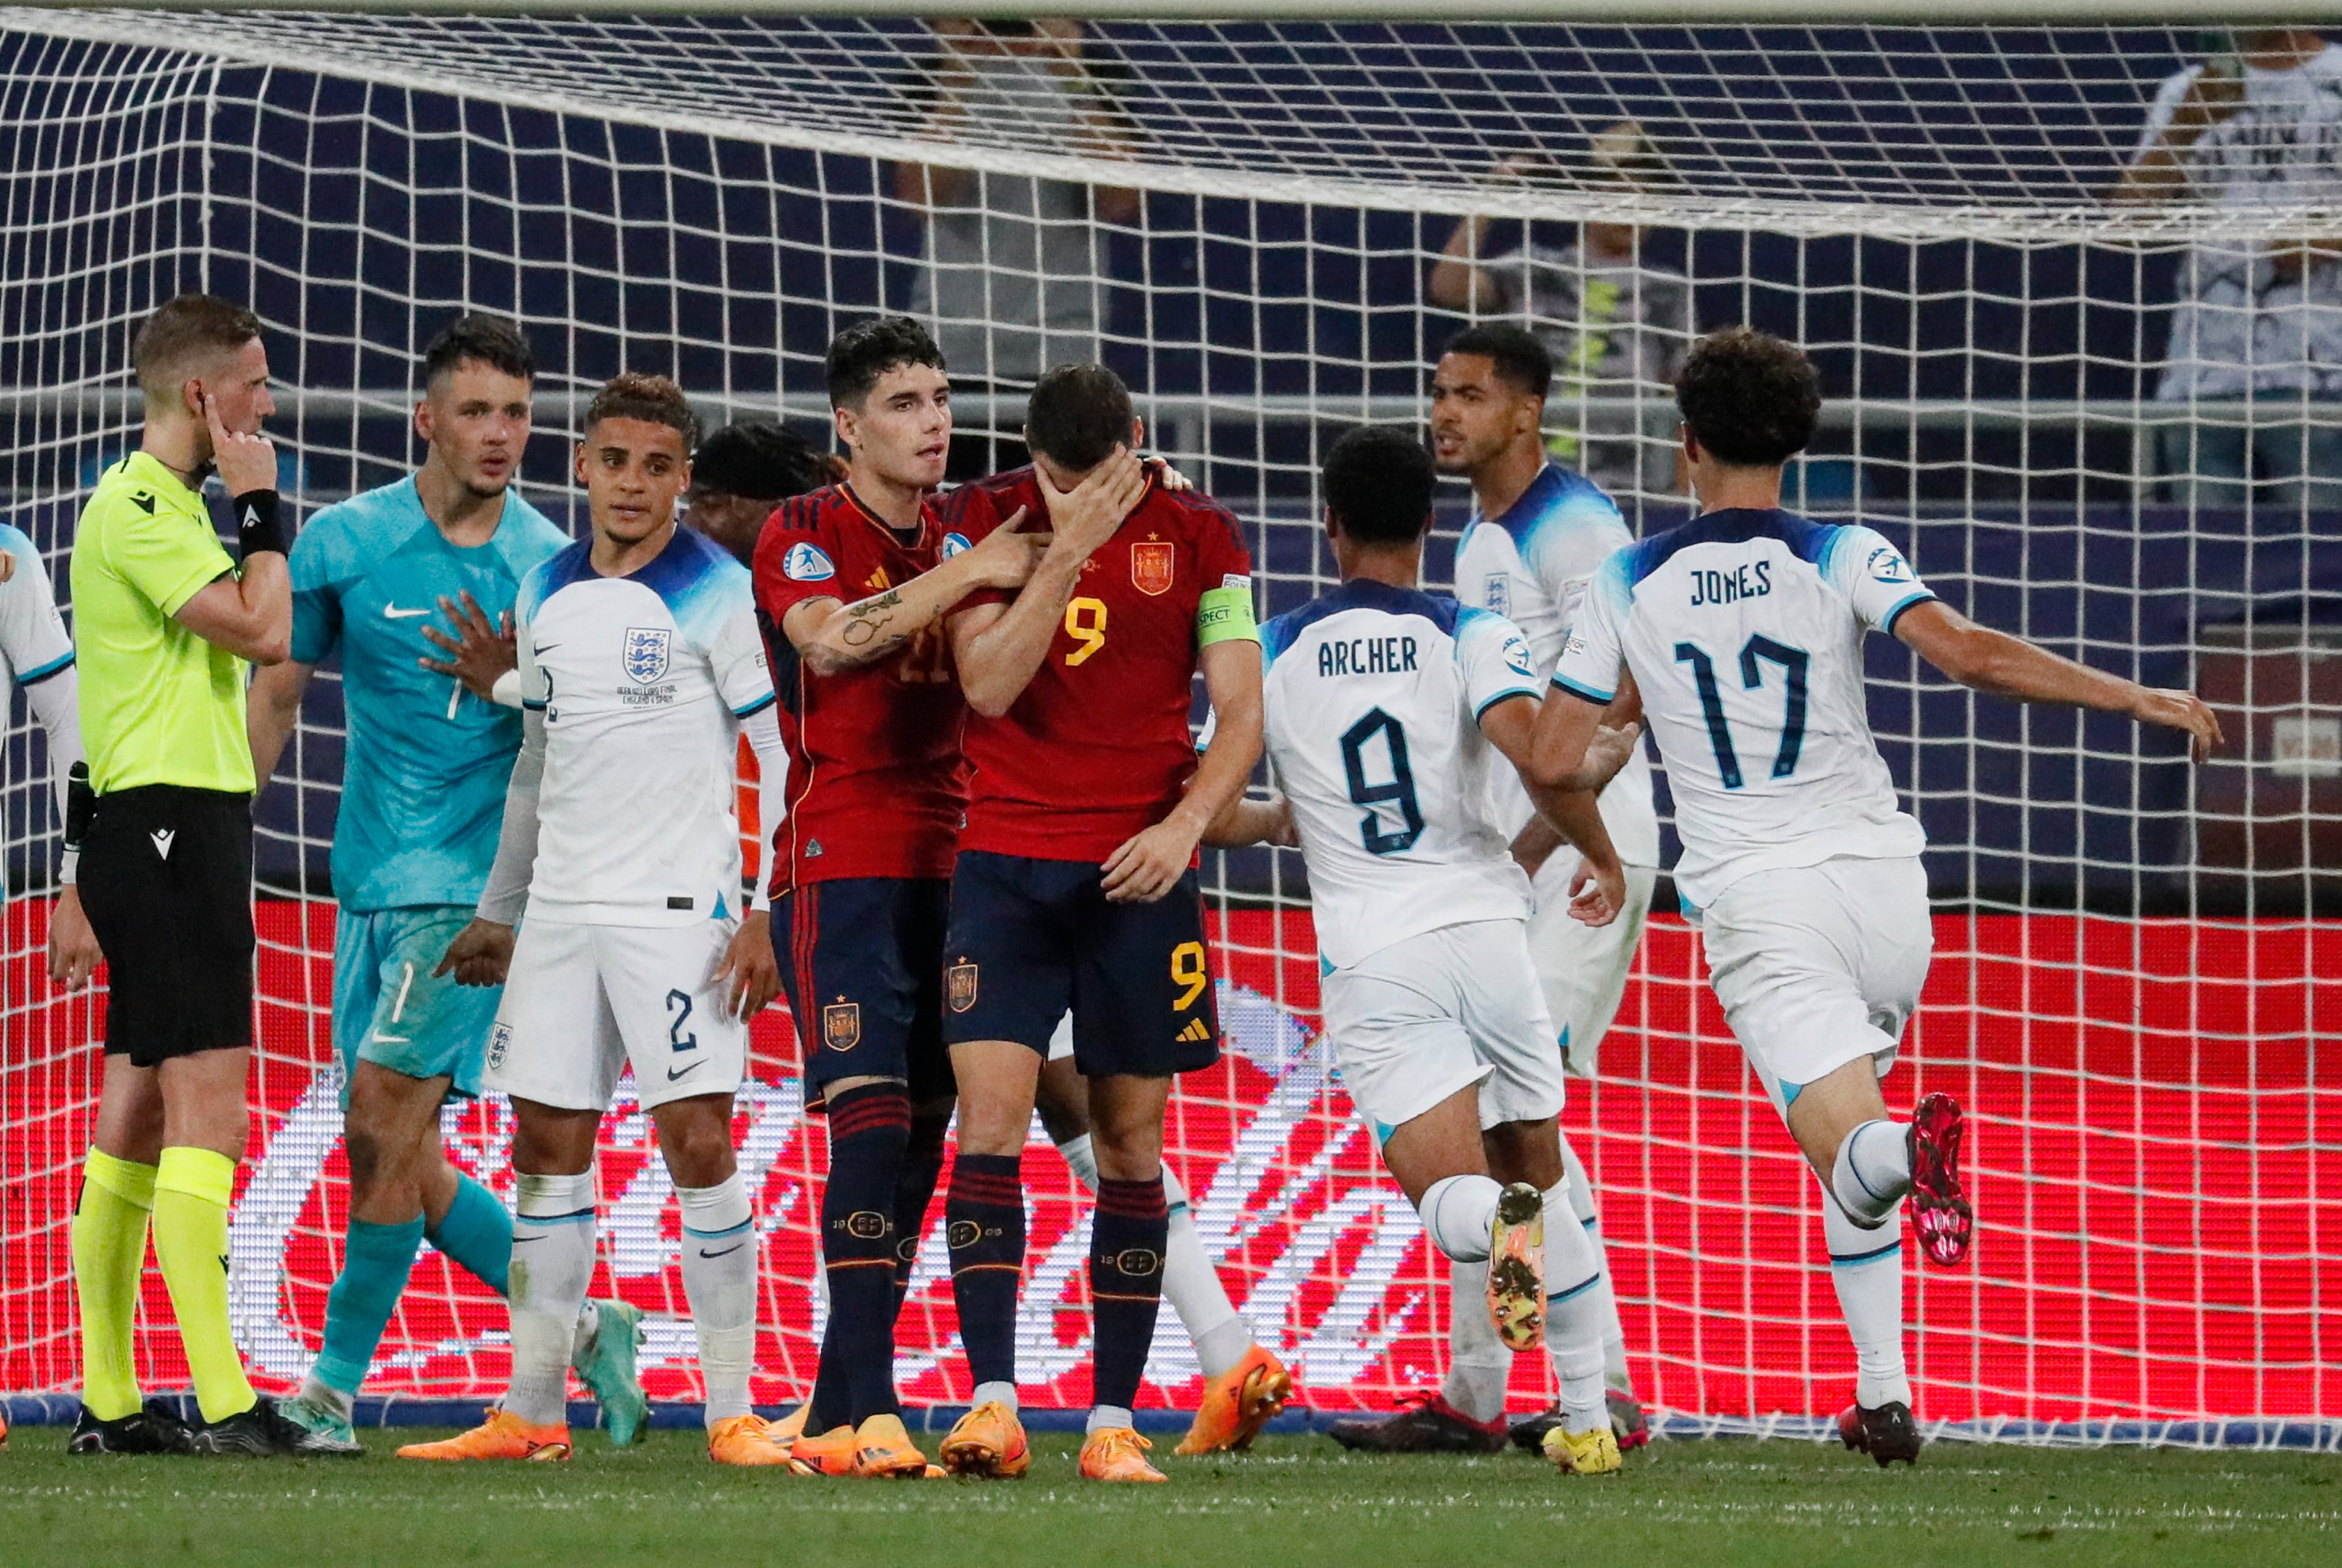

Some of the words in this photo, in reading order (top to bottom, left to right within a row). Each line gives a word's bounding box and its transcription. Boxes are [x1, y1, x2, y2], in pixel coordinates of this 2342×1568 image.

[1690, 560, 1771, 606] JONES
[1065, 597, 1108, 666] 9
[1318, 636, 1418, 677] ARCHER
[623, 696, 649, 704] ENGLAND
[655, 695, 674, 704] SPAIN
[1673, 630, 1810, 790] 17
[1339, 705, 1426, 856] 9
[391, 962, 414, 1024] 1
[1170, 941, 1206, 1012] 9
[666, 988, 697, 1053] 2
